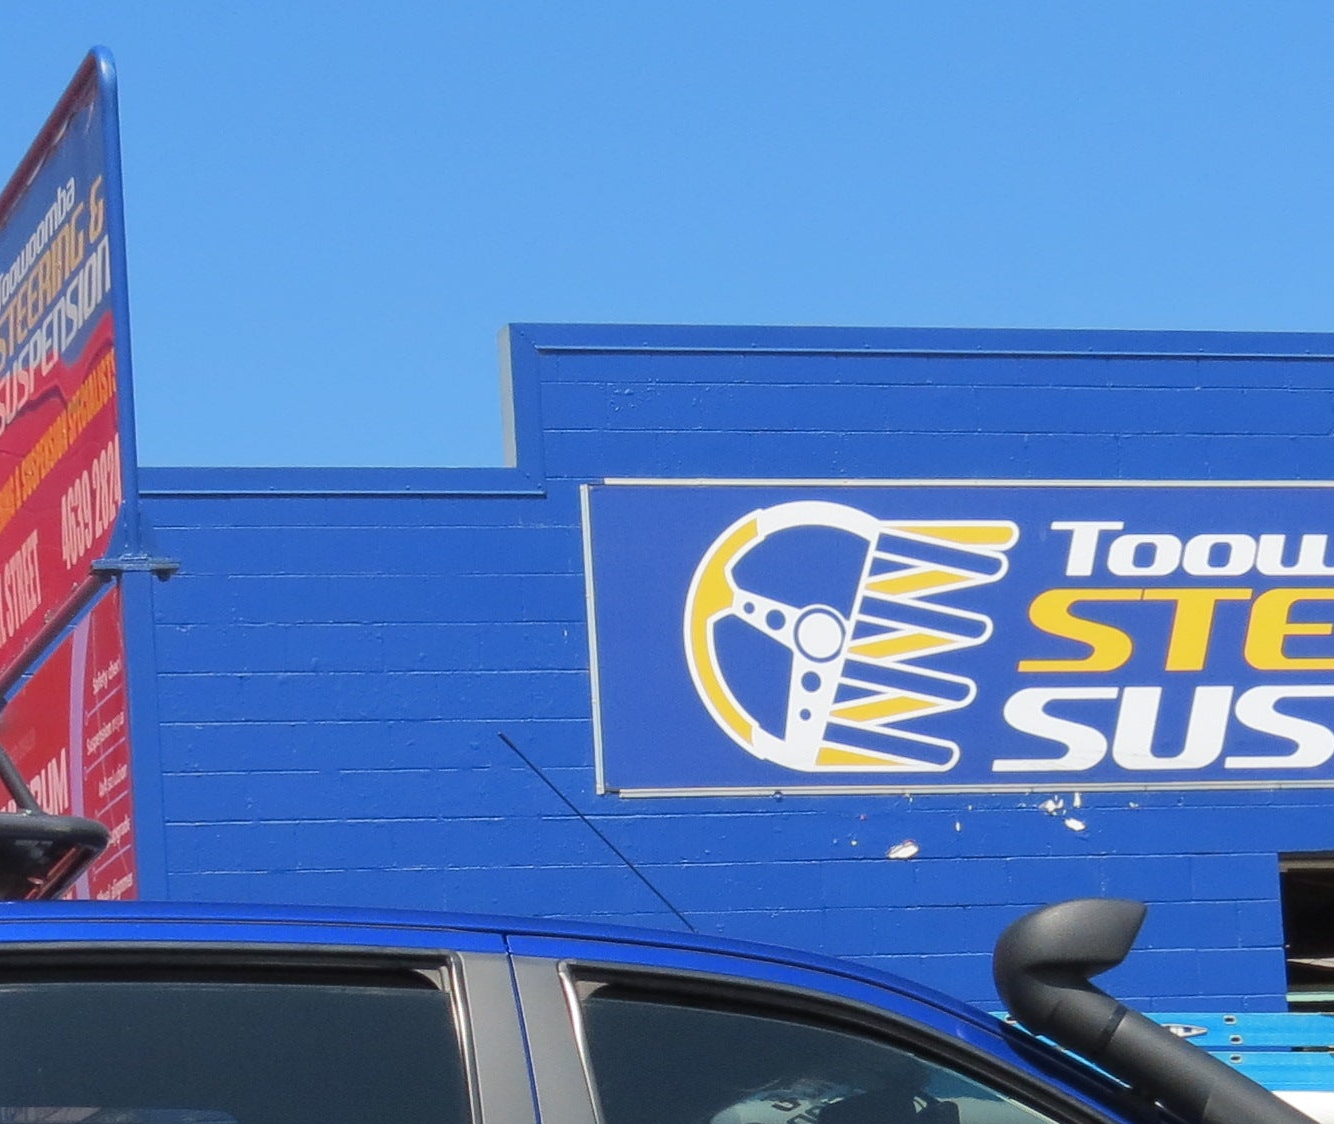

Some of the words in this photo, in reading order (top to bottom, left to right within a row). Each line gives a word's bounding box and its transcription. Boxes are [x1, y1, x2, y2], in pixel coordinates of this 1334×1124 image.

[88, 175, 105, 245] &
[61, 470, 93, 569] 4639
[92, 432, 122, 539] 2824
[4, 529, 42, 638] STREET
